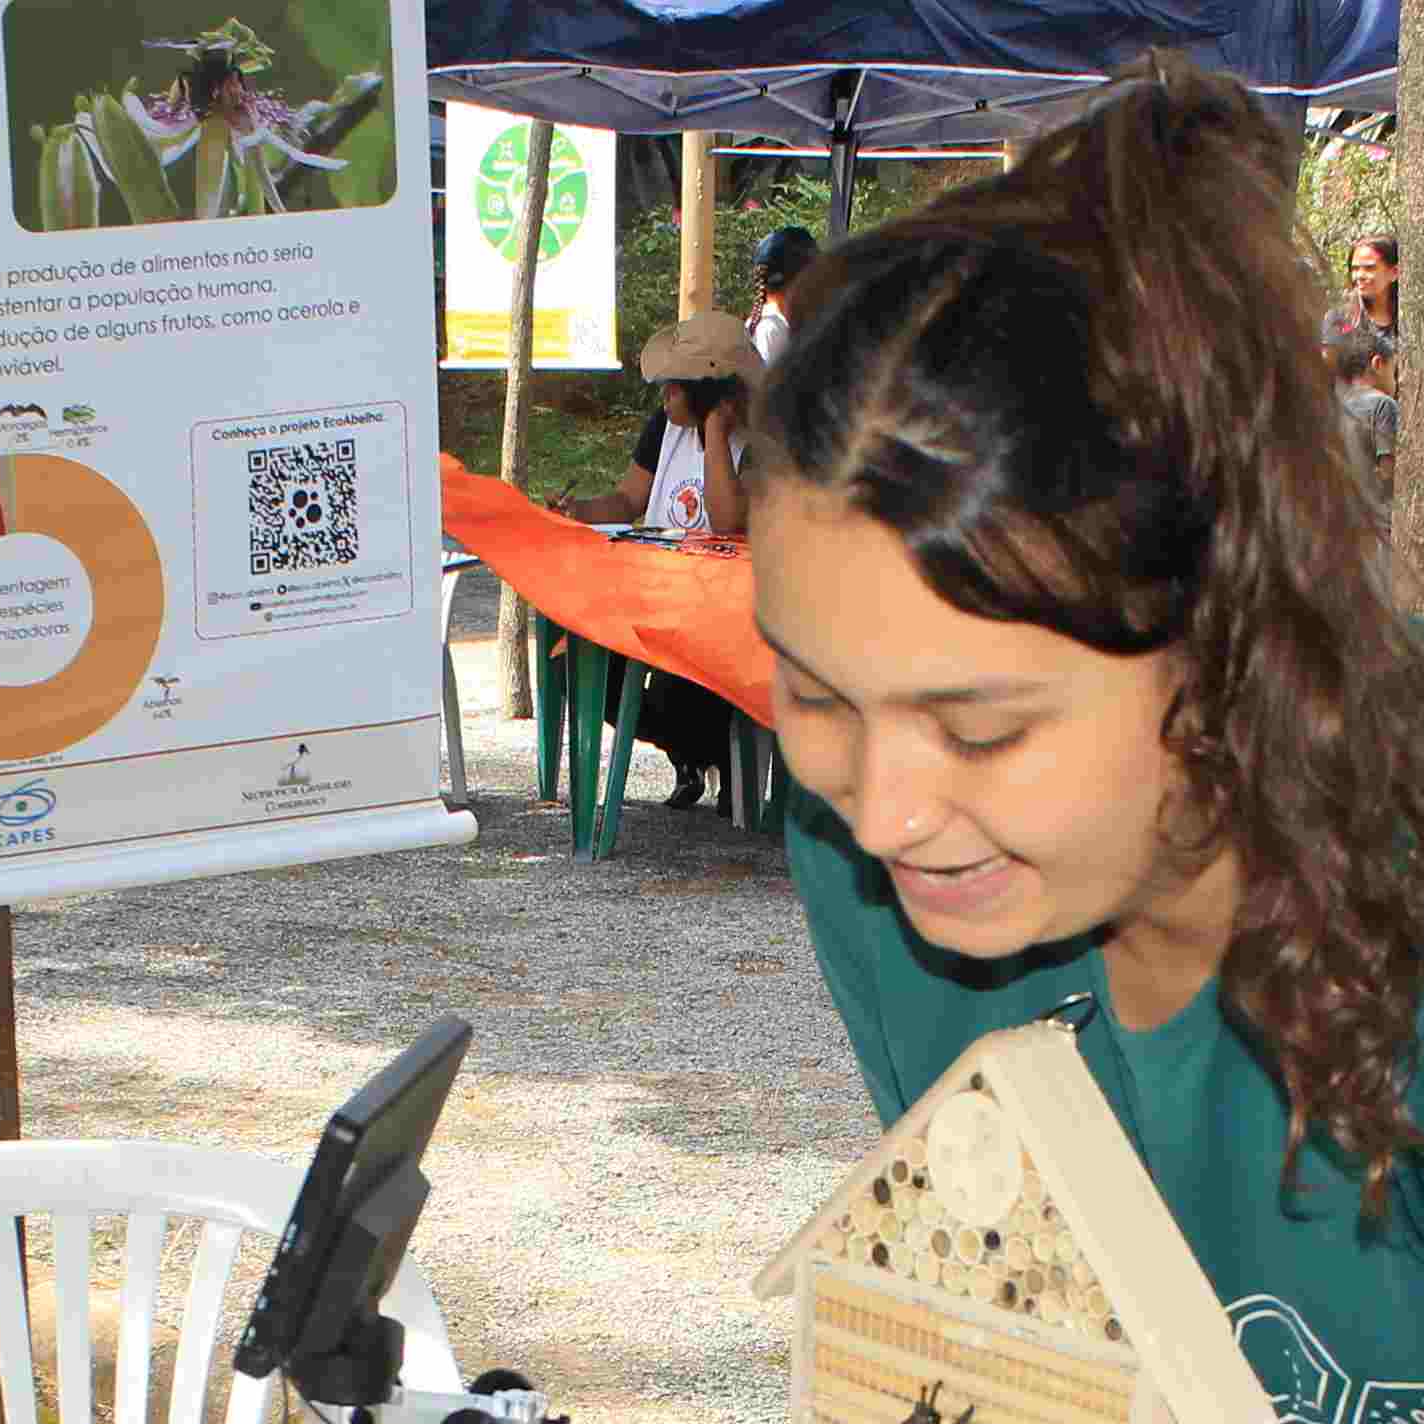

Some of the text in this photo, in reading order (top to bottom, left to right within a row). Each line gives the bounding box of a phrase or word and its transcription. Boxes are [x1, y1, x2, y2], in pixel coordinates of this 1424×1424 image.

[7, 260, 106, 289] produção
[106, 258, 137, 278] de
[141, 251, 230, 274] alimentos
[230, 246, 269, 265] não
[270, 242, 314, 263] seria
[67, 295, 83, 313] a
[86, 283, 194, 313] população
[196, 279, 278, 299] humana.
[63, 322, 91, 342] de
[95, 319, 159, 342] alguns
[158, 311, 218, 333] frutos,
[220, 308, 273, 327] como
[277, 299, 345, 321] acerola
[348, 299, 361, 315] e
[211, 425, 267, 441] Conheça
[269, 423, 278, 435] o
[279, 418, 321, 436] projeto
